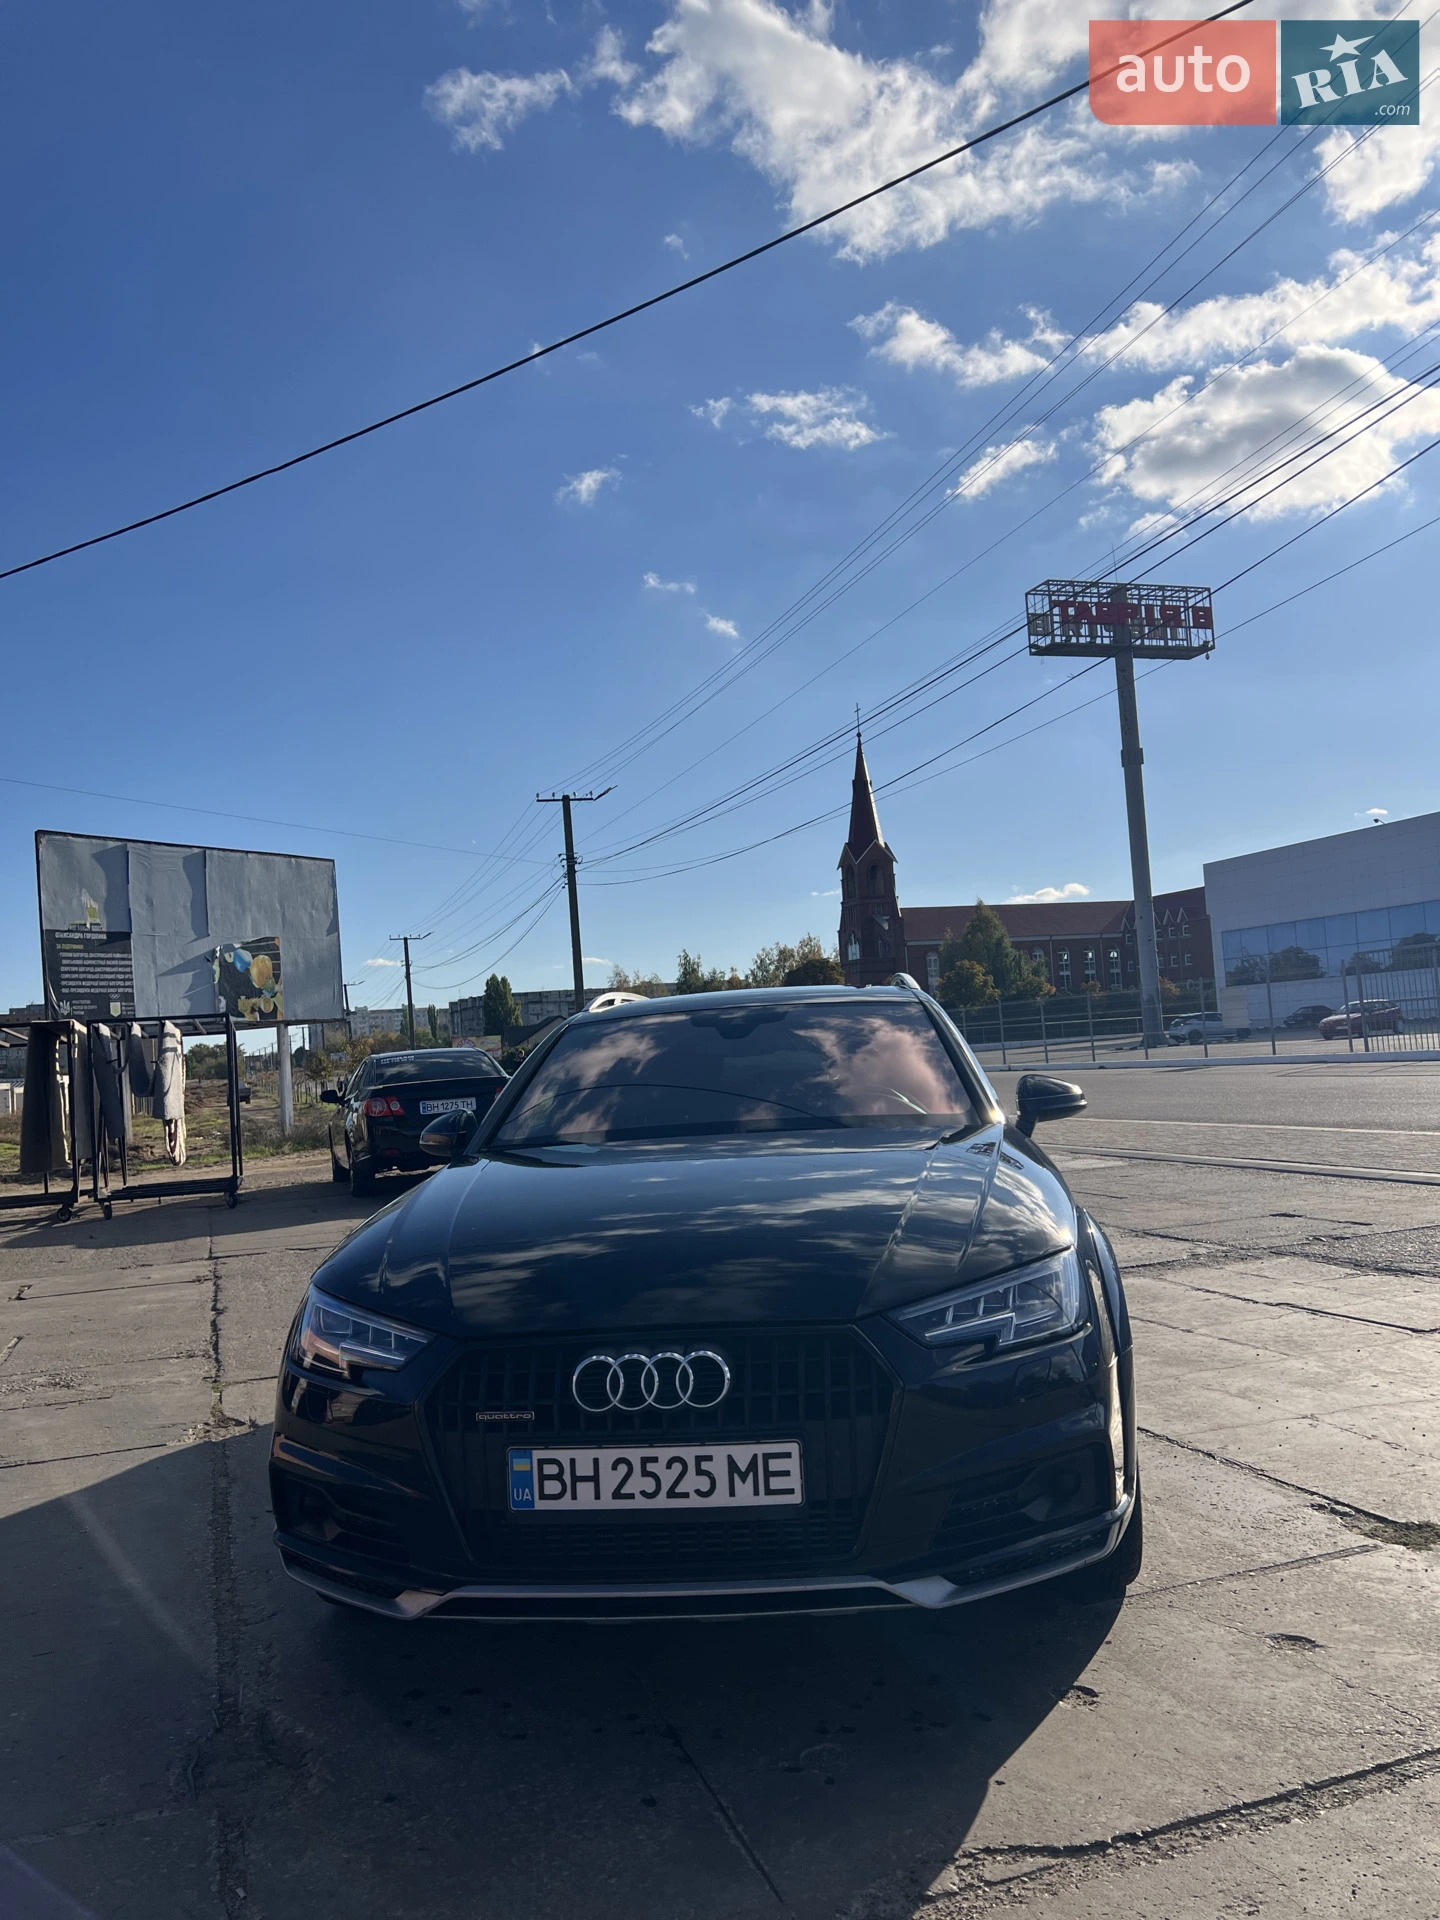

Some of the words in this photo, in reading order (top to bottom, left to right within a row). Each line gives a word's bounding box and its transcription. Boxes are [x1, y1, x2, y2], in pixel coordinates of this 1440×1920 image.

[441, 1101, 459, 1110] 1275
[478, 1412, 532, 1421] quattro
[536, 1457, 600, 1501] BH
[611, 1454, 717, 1500] 2525
[727, 1451, 795, 1497] ME
[513, 1488, 532, 1502] UA
